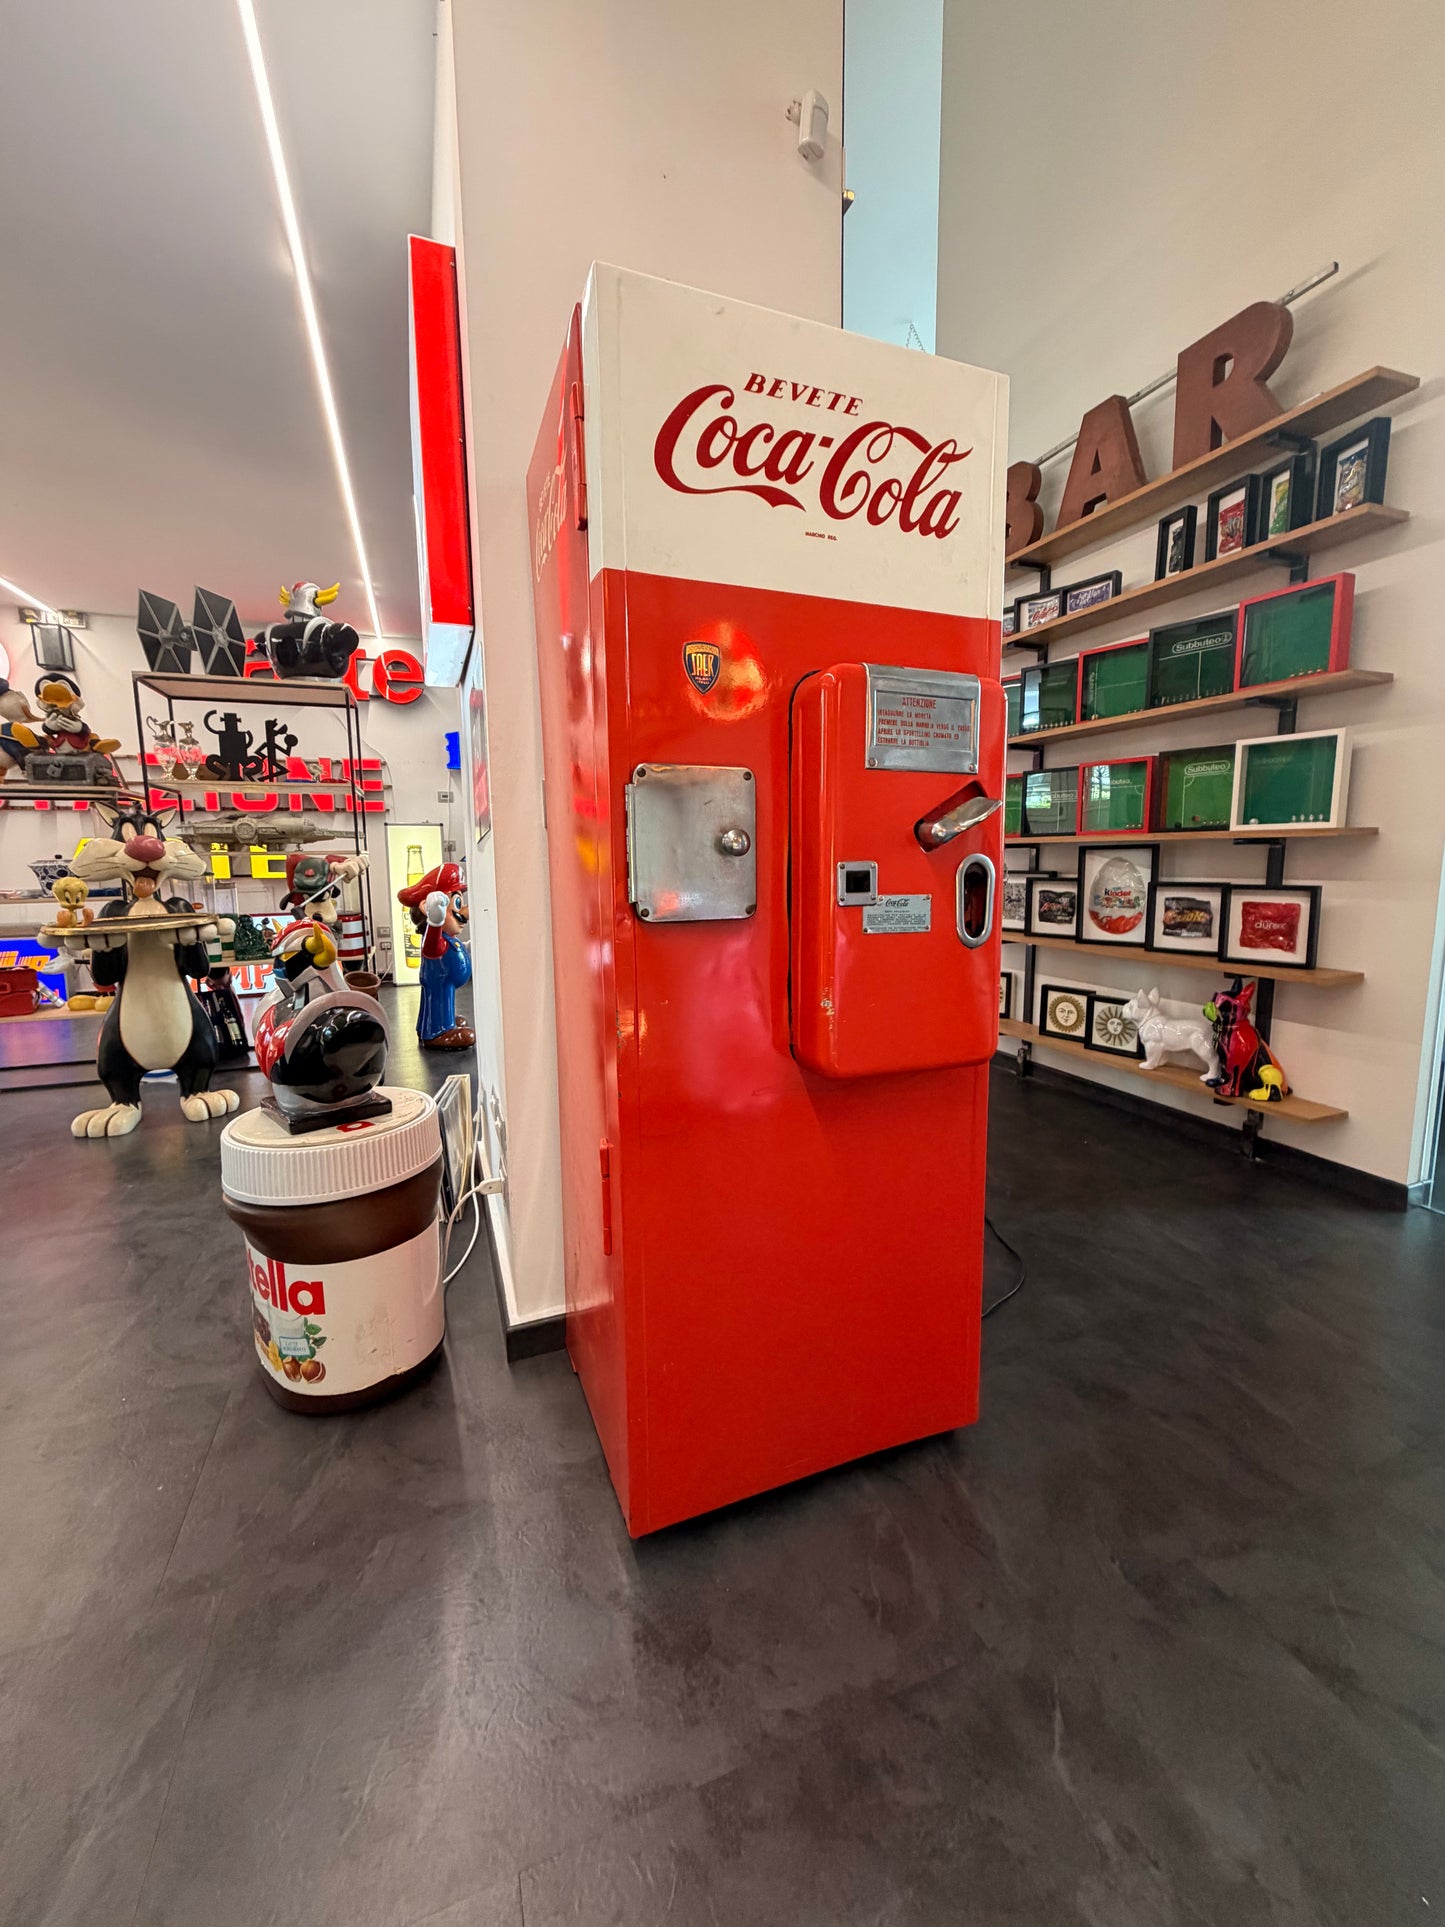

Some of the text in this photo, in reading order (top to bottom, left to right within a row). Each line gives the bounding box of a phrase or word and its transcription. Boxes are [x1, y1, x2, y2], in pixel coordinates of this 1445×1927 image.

[743, 372, 864, 417] BEVETE
[653, 384, 975, 539] Coca-Cola
[1174, 636, 1222, 652] Subbuteo
[902, 696, 937, 709] ATTENZIONE
[1186, 762, 1226, 775] Subbuteo
